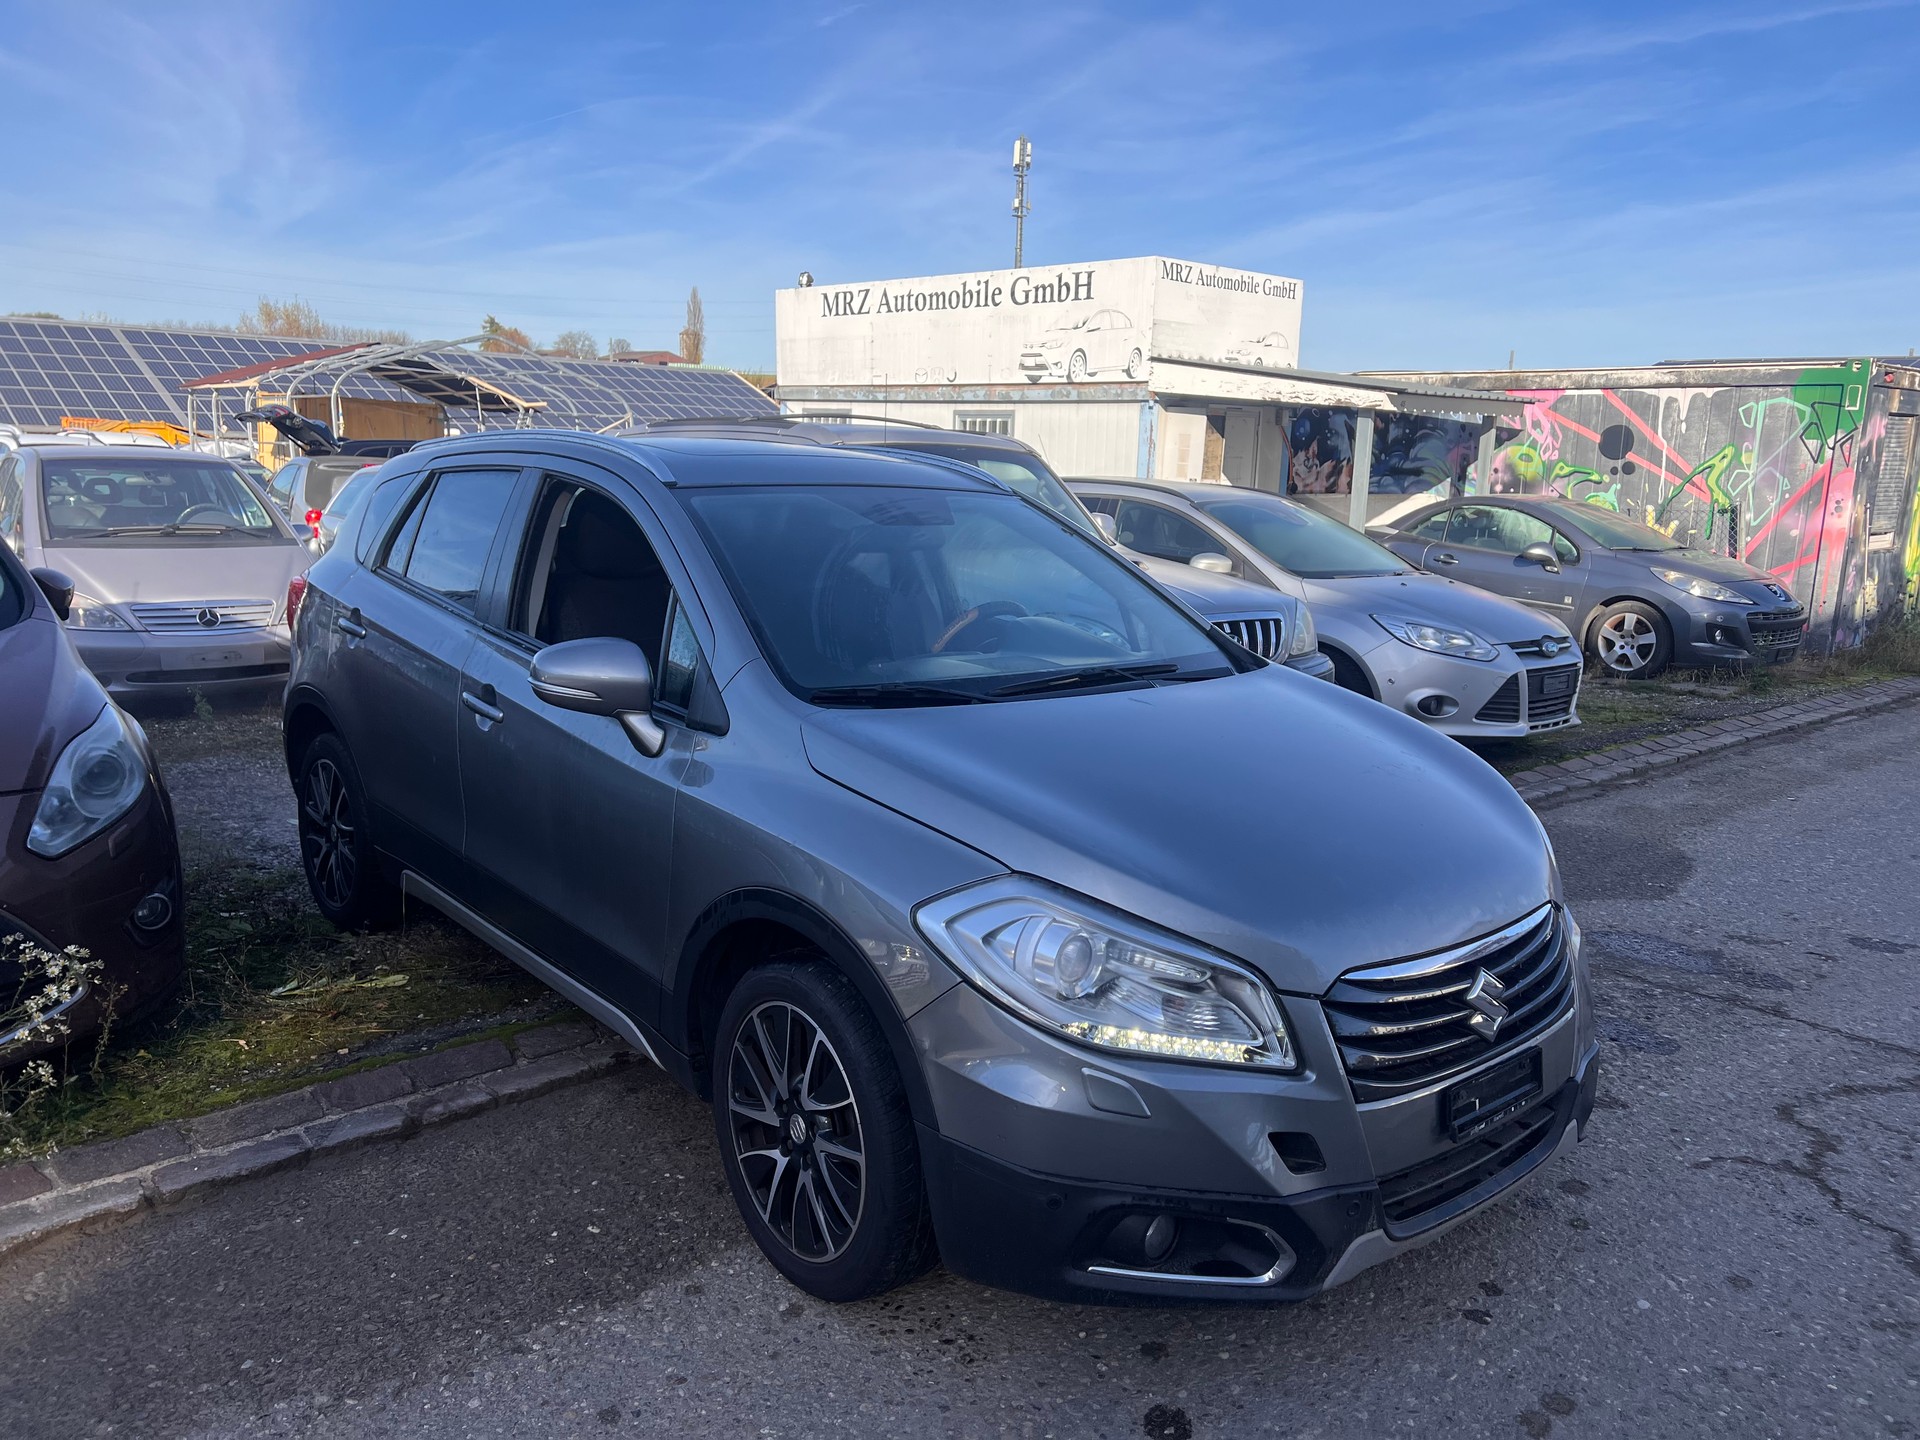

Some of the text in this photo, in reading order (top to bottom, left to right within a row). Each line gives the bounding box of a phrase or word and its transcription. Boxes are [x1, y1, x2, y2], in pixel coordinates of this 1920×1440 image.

[820, 270, 1096, 318] MRZ Automobile GmbH
[1161, 259, 1297, 300] MRZ Automobile GmbH
